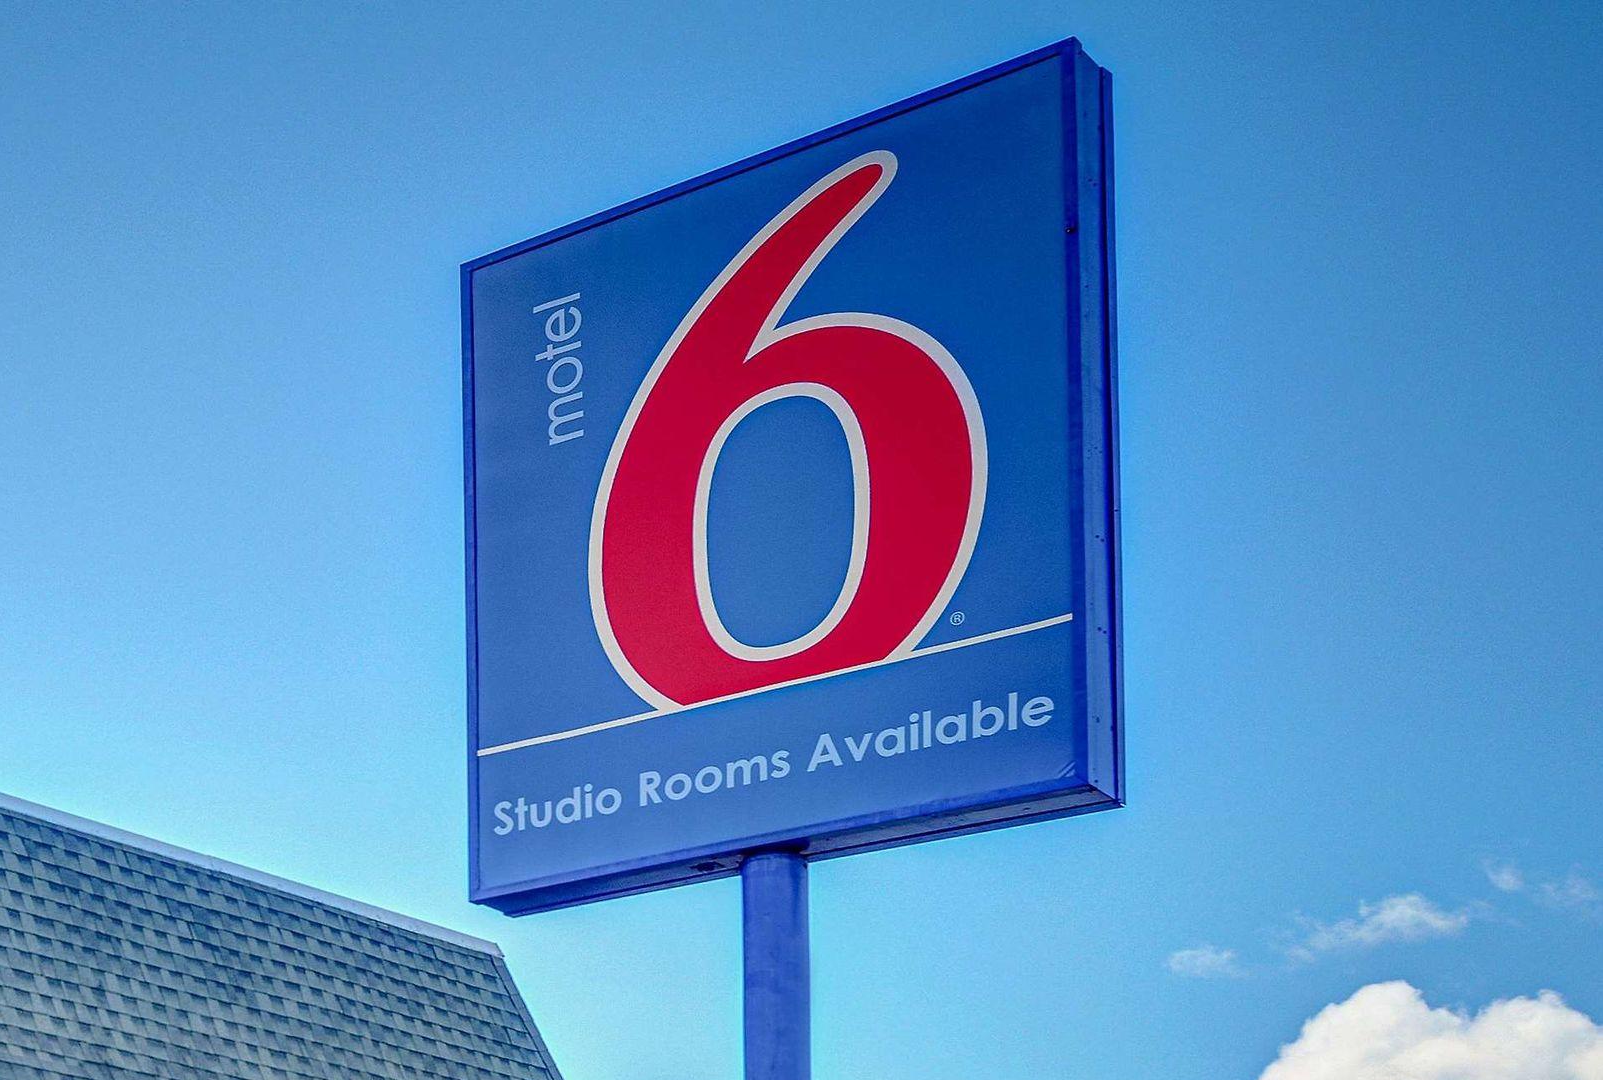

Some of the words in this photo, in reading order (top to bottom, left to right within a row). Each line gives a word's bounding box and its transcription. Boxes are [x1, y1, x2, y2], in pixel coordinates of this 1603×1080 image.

[533, 293, 584, 445] motel
[588, 150, 988, 711] 6
[493, 784, 622, 836] Studio
[639, 750, 790, 806] Rooms
[807, 693, 1055, 772] Available
